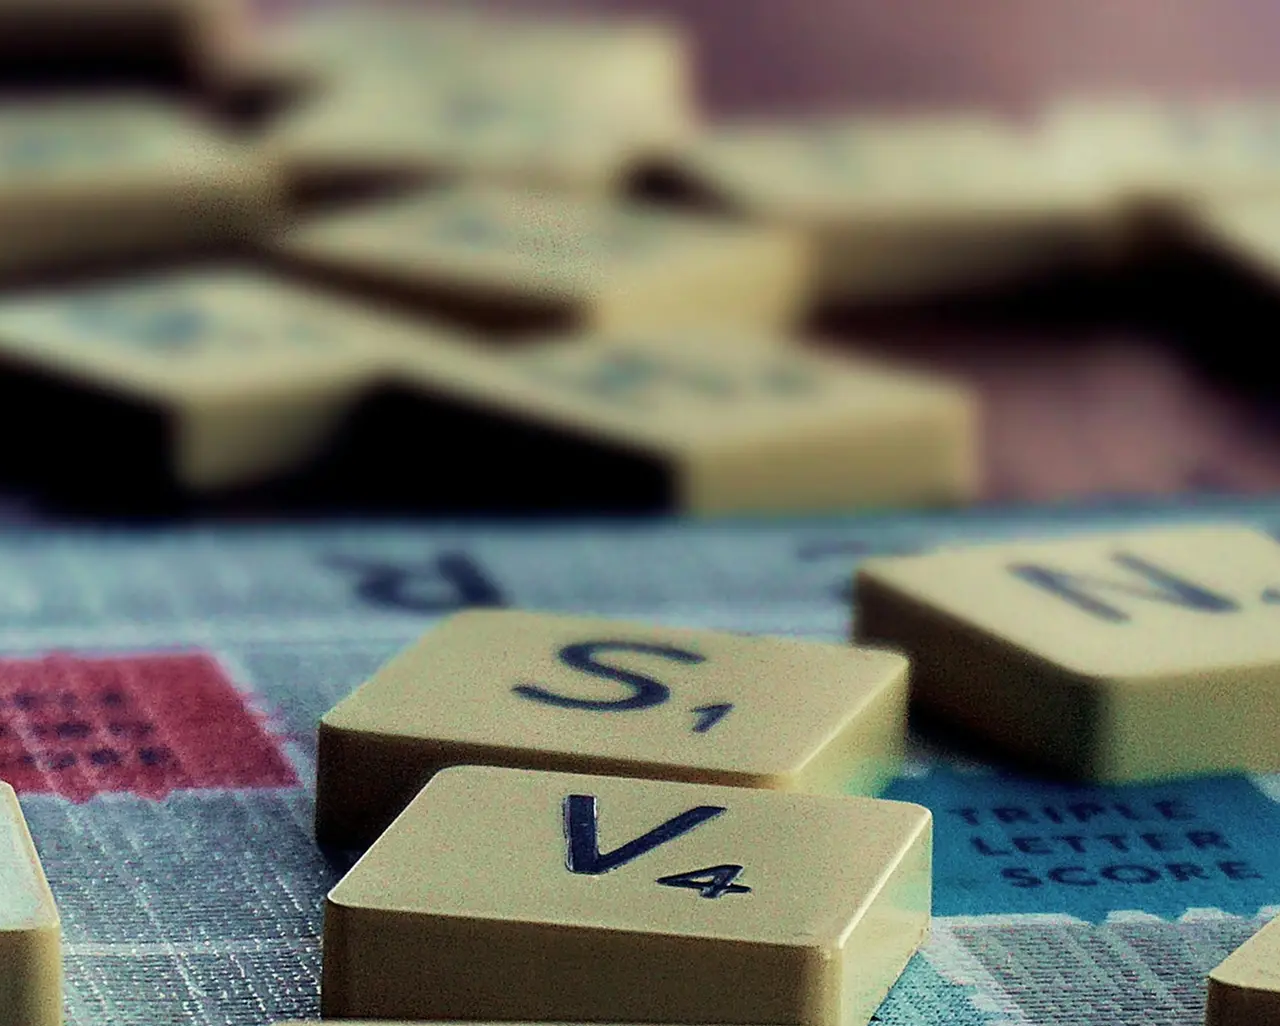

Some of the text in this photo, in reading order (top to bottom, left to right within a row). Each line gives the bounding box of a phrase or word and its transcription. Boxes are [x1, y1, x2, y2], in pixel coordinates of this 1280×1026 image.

[1008, 550, 1244, 624] N
[511, 640, 734, 734] S 1
[944, 799, 1200, 827] TRIPLE
[561, 794, 753, 899] V 4
[970, 829, 1232, 858] LETTER
[999, 859, 1264, 890] SCORE
